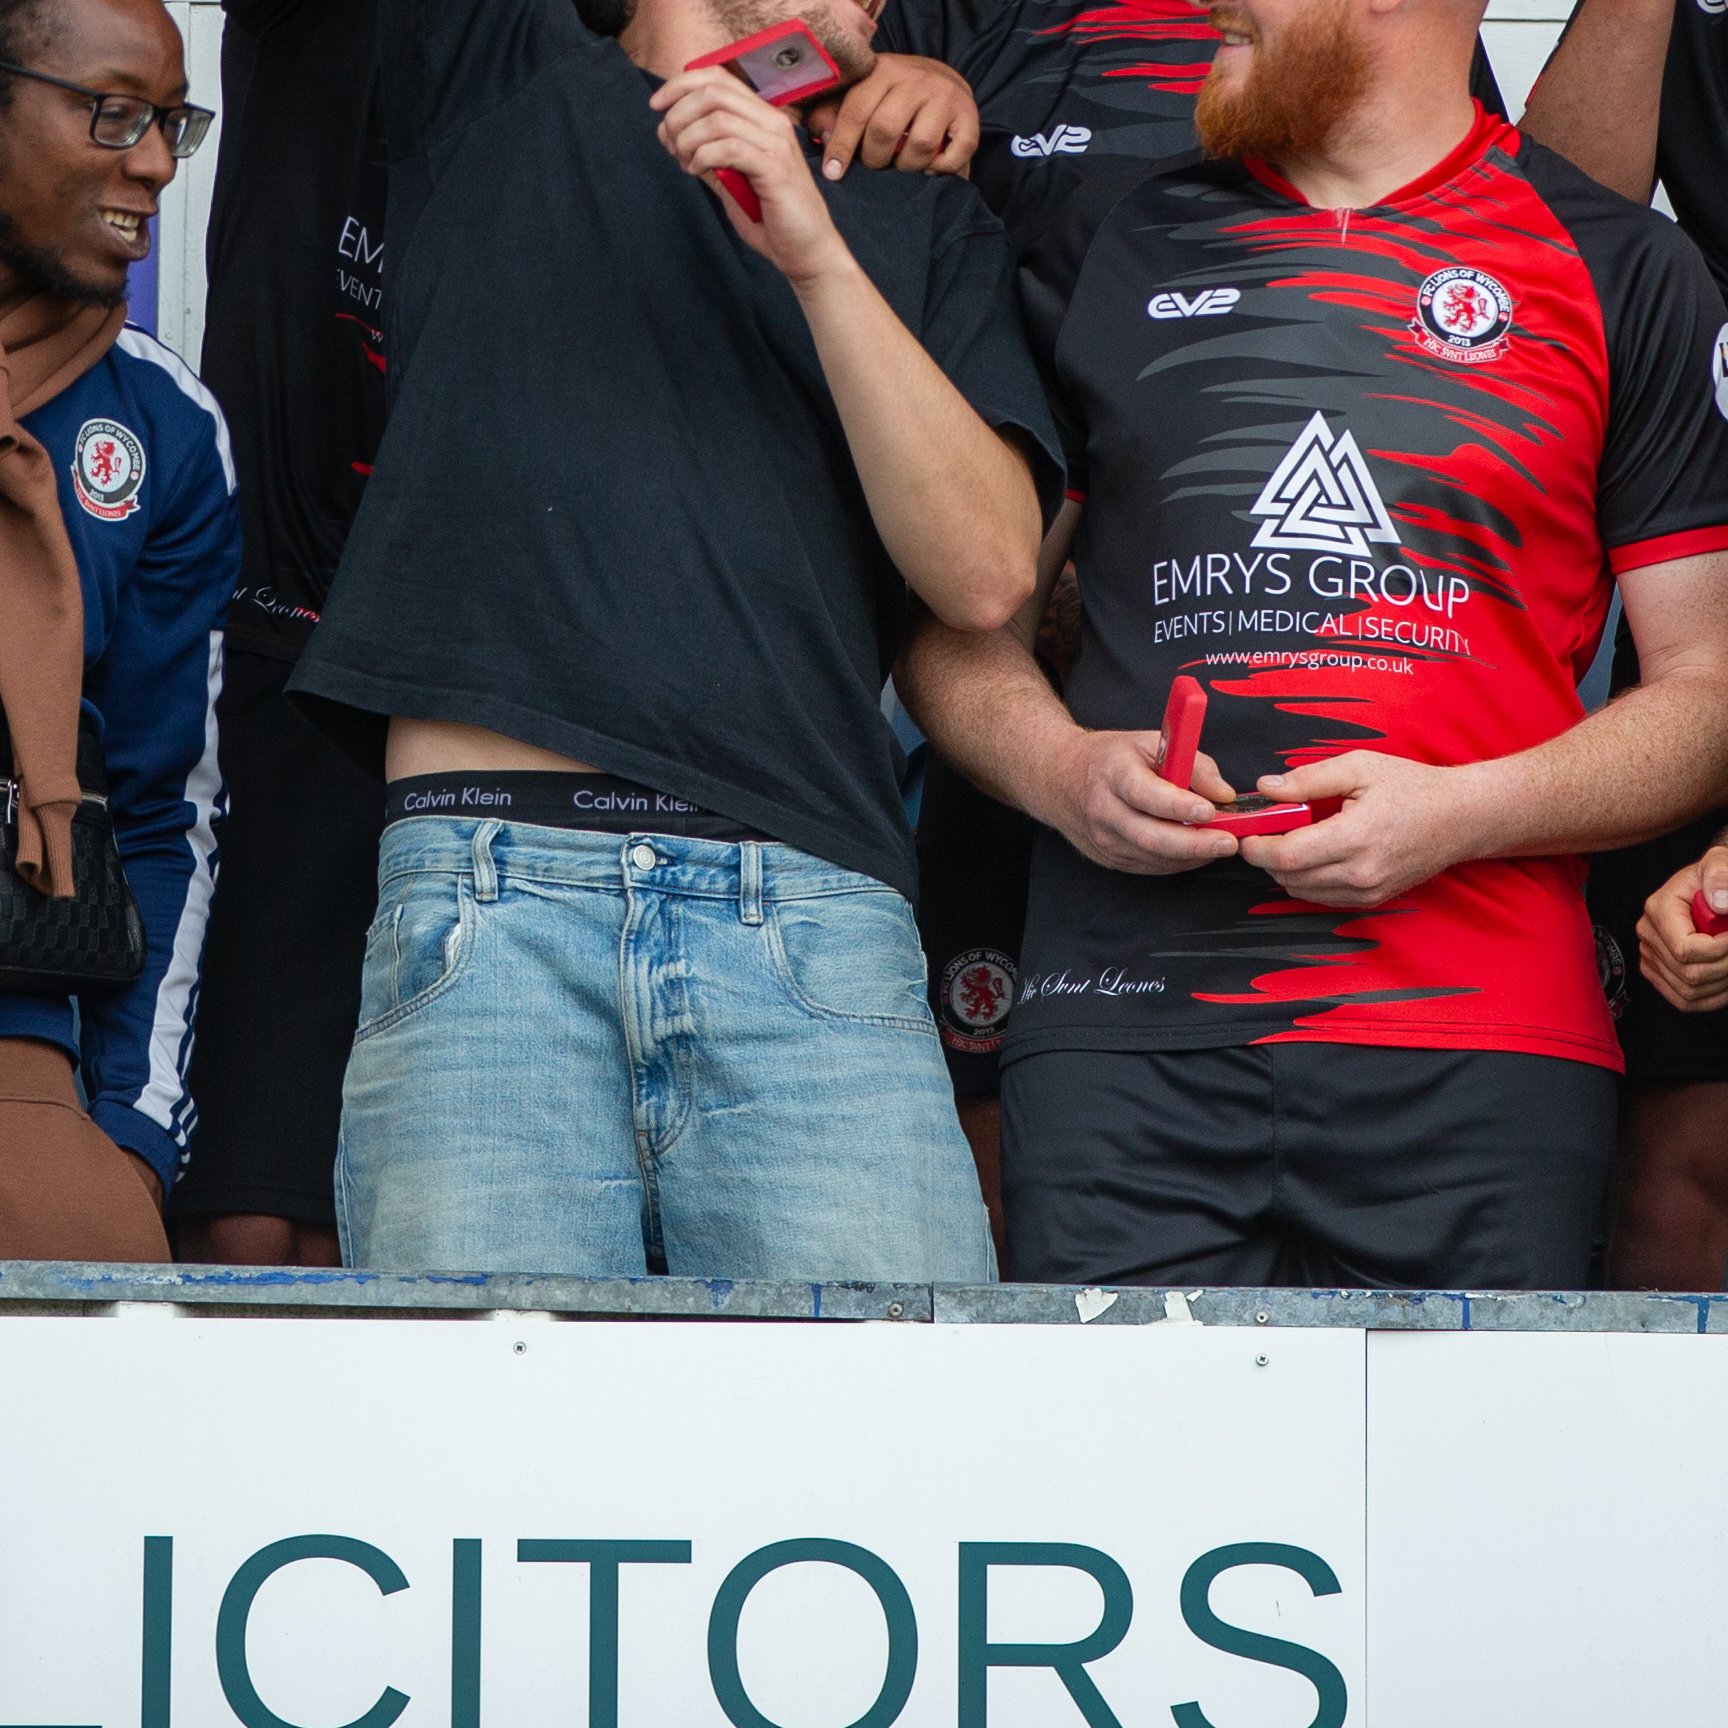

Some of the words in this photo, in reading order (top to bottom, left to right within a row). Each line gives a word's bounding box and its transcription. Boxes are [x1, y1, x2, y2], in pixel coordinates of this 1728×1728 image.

[1422, 285, 1436, 297] FC
[1430, 270, 1459, 287] LIONS
[1459, 269, 1475, 279] OF
[1475, 272, 1510, 312] WYCOMBE
[1447, 334, 1471, 347] 2013
[104, 424, 116, 433] OF
[115, 428, 141, 471] WYCOMBE
[1153, 552, 1292, 606] EMRYS
[1308, 555, 1470, 619] GROUP
[1205, 648, 1414, 675] www.emrysgroup.co.uk
[404, 788, 456, 811] Calvin
[461, 787, 512, 806] Klein
[573, 790, 648, 812] Calvin
[968, 951, 982, 961] OF
